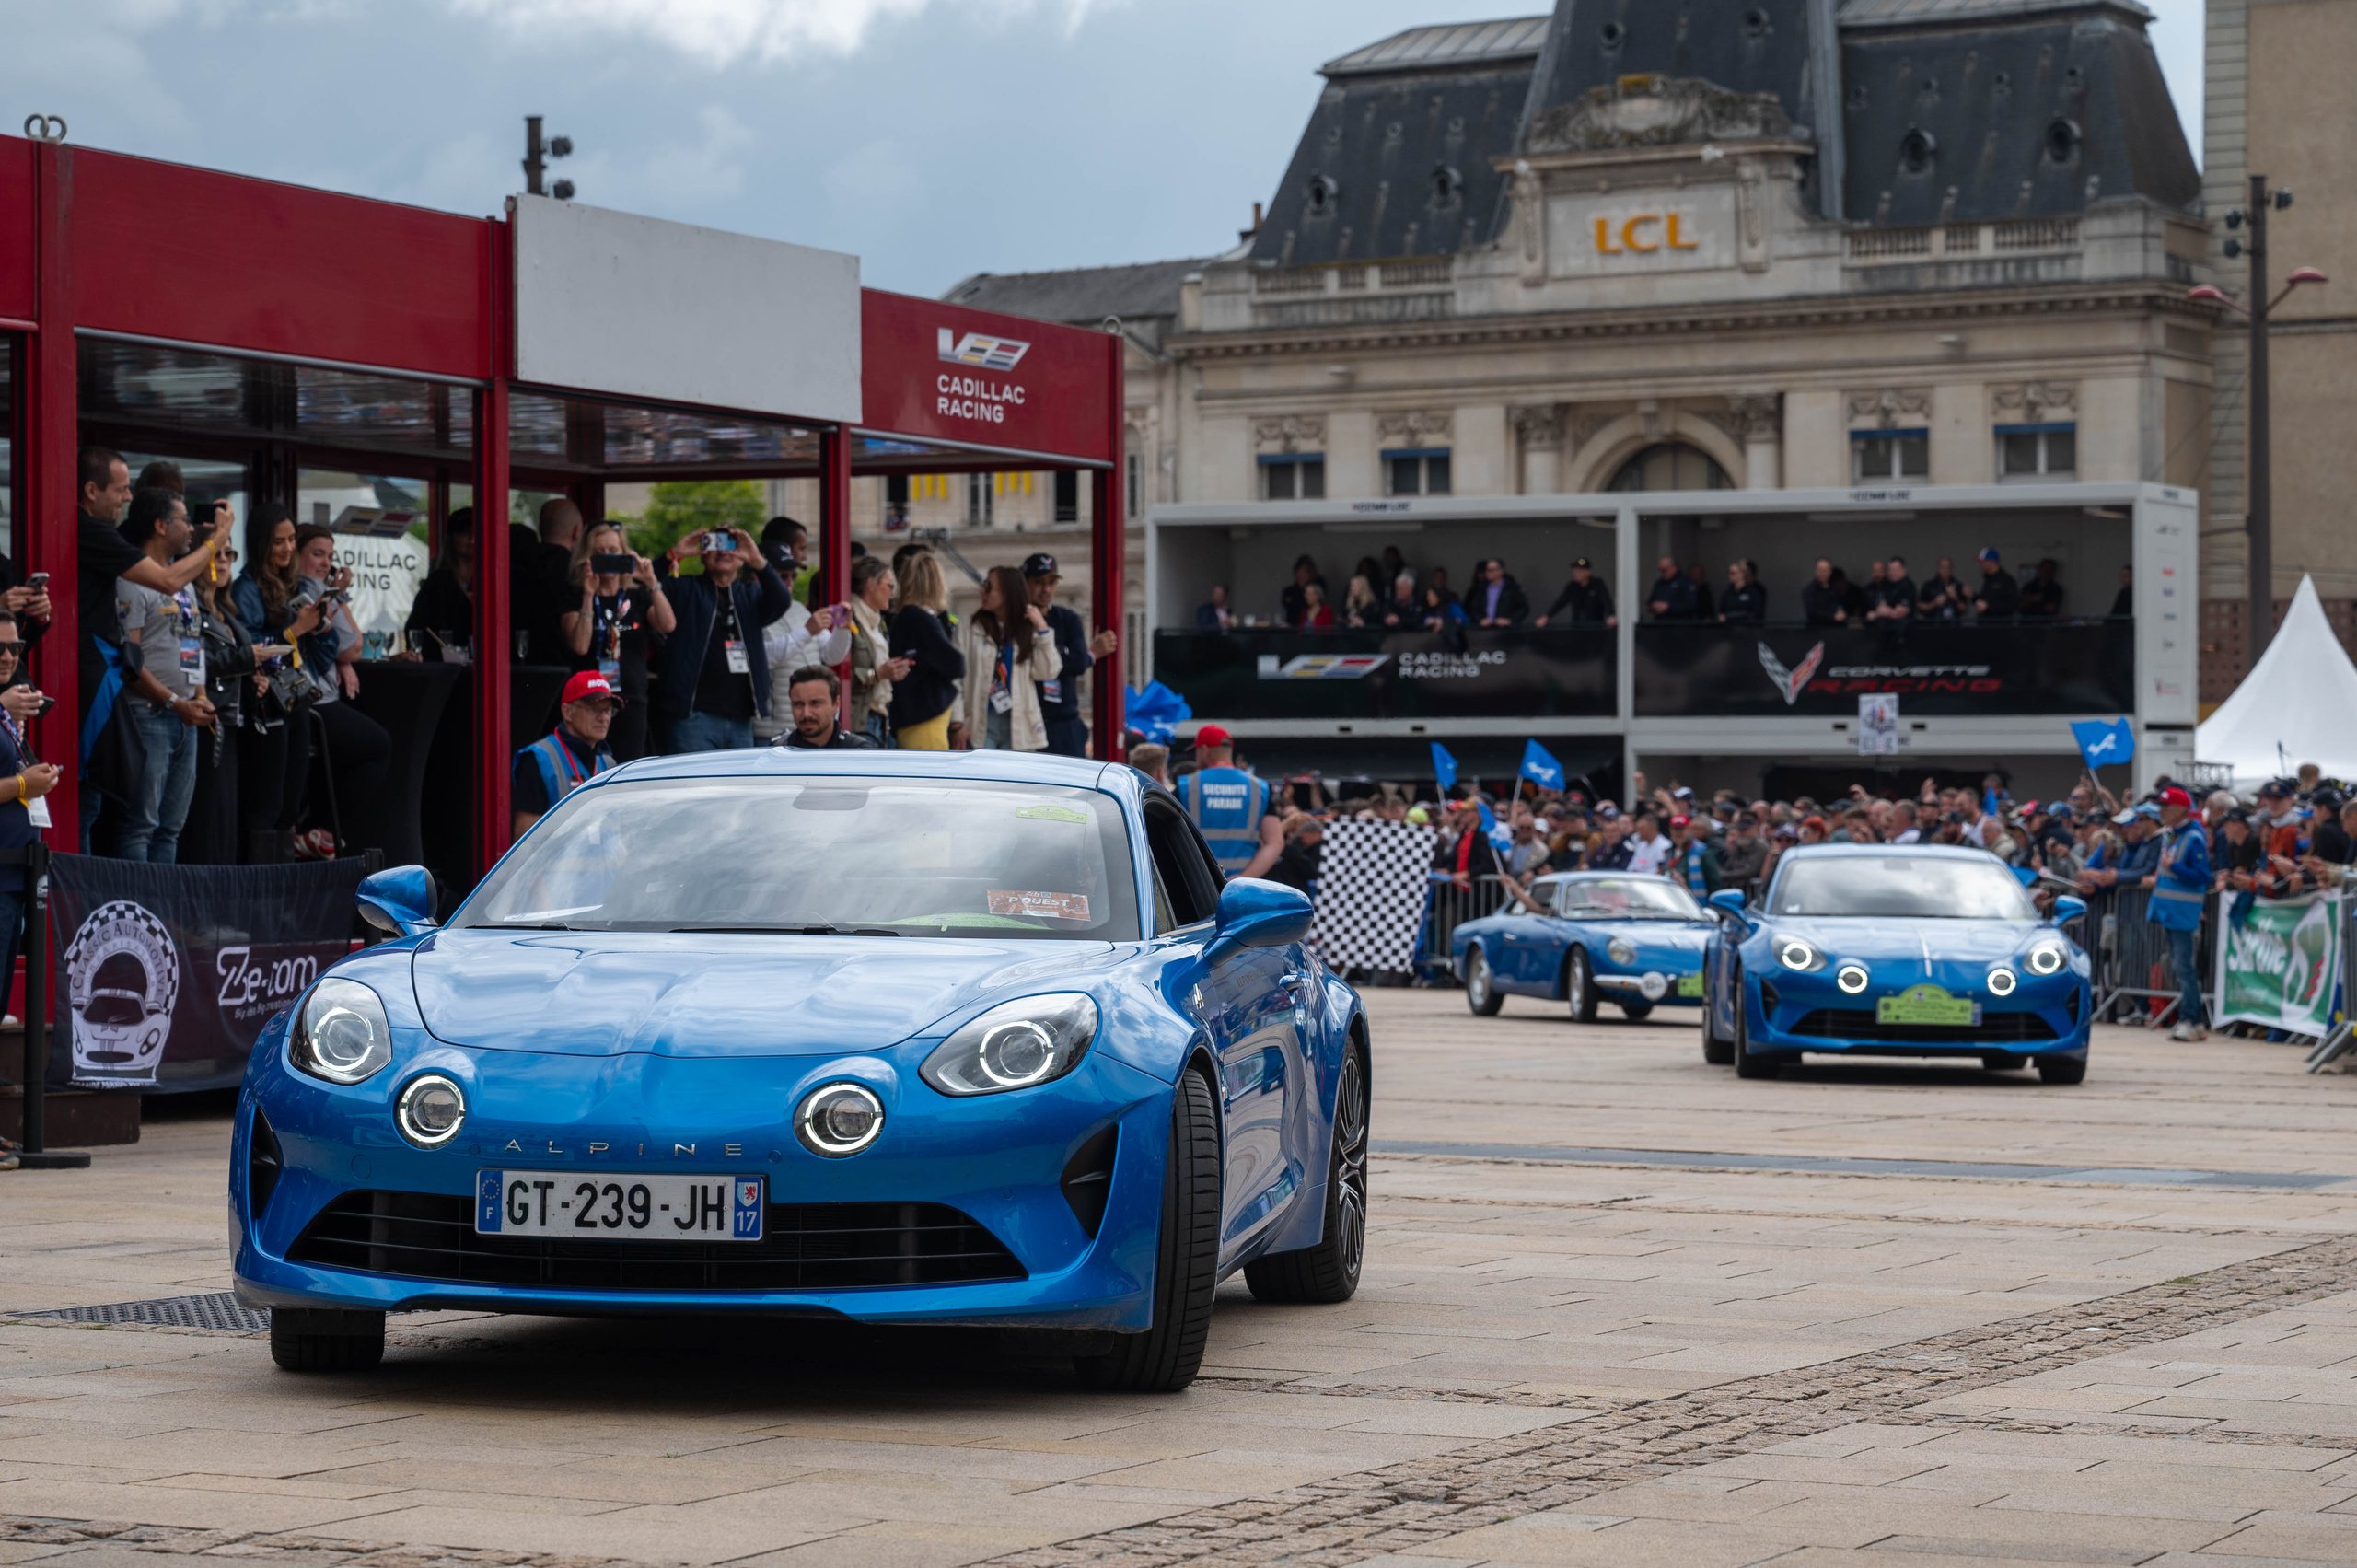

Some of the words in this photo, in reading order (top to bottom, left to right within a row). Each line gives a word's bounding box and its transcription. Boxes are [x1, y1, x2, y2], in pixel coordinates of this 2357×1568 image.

[1594, 213, 1699, 255] LCL
[937, 374, 1025, 404] CADILLAC
[937, 396, 1004, 424] RACING
[332, 550, 416, 571] ADILLAC
[1399, 651, 1507, 666] CADILLAC
[1399, 666, 1480, 678] RACING
[1828, 666, 1991, 678] CORVETTE
[1806, 679, 2003, 692] RACING
[1207, 797, 1243, 809] PARADE
[1022, 897, 1071, 907] OUEST
[73, 929, 110, 990] CLASSIC
[113, 922, 166, 995] AUTOMOTIVE
[505, 1138, 742, 1156] ALPINE
[486, 1206, 493, 1220] F
[506, 1180, 725, 1231] GT-239-JH
[737, 1211, 758, 1233] 17
